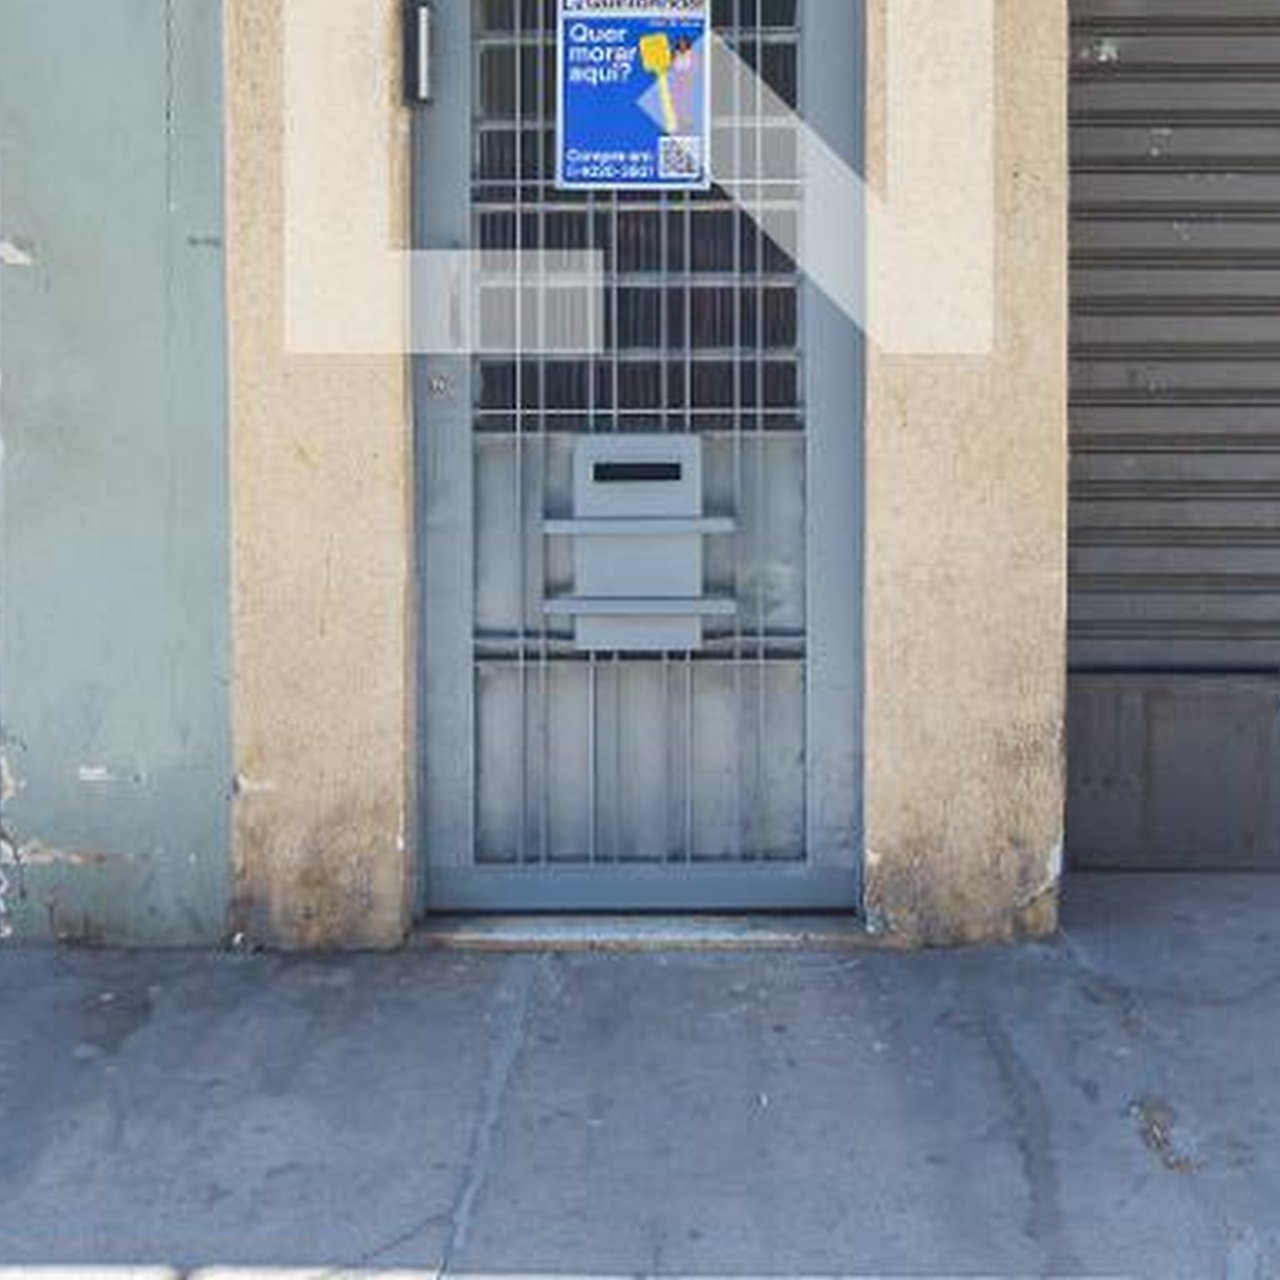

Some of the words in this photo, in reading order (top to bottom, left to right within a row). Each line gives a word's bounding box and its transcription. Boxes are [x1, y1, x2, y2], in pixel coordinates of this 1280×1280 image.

[570, 23, 627, 44] Quer
[570, 46, 637, 63] morar
[569, 63, 632, 87] aqui?
